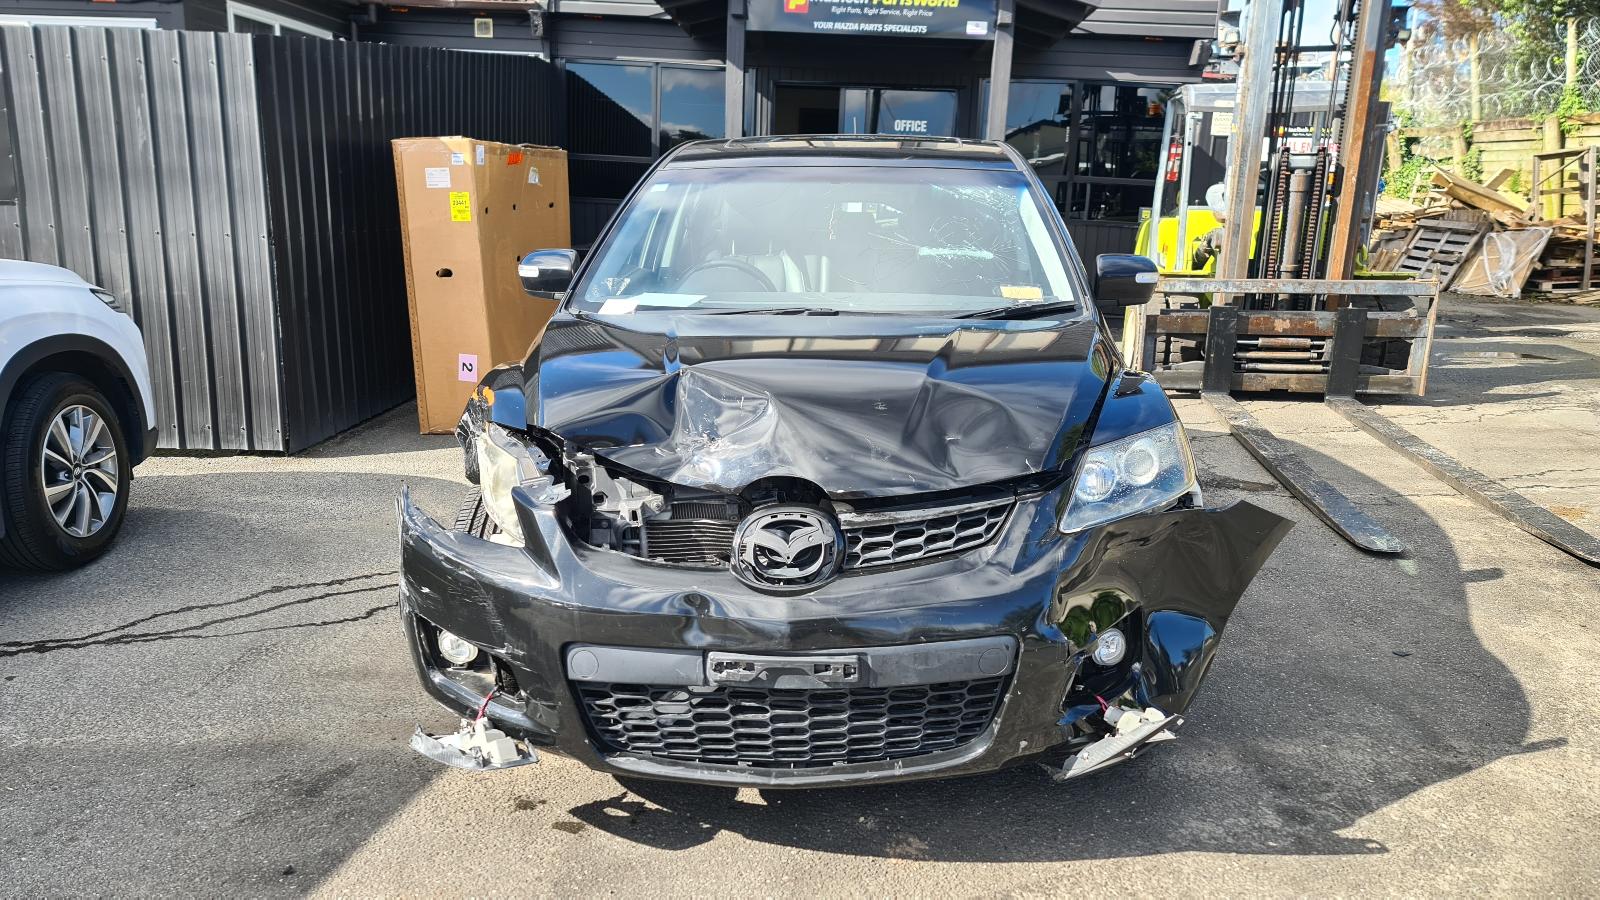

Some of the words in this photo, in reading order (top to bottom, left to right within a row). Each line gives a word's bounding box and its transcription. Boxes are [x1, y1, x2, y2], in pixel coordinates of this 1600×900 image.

[831, 6, 846, 14] Right
[864, 7, 879, 16] Right
[903, 9, 918, 17] Right
[813, 21, 833, 29] YOUR
[834, 22, 859, 30] MAZDA
[859, 23, 882, 31] PARTS
[882, 24, 927, 33] SPECIALISTS
[894, 120, 928, 132] OFFICE
[462, 362, 473, 373] 2
